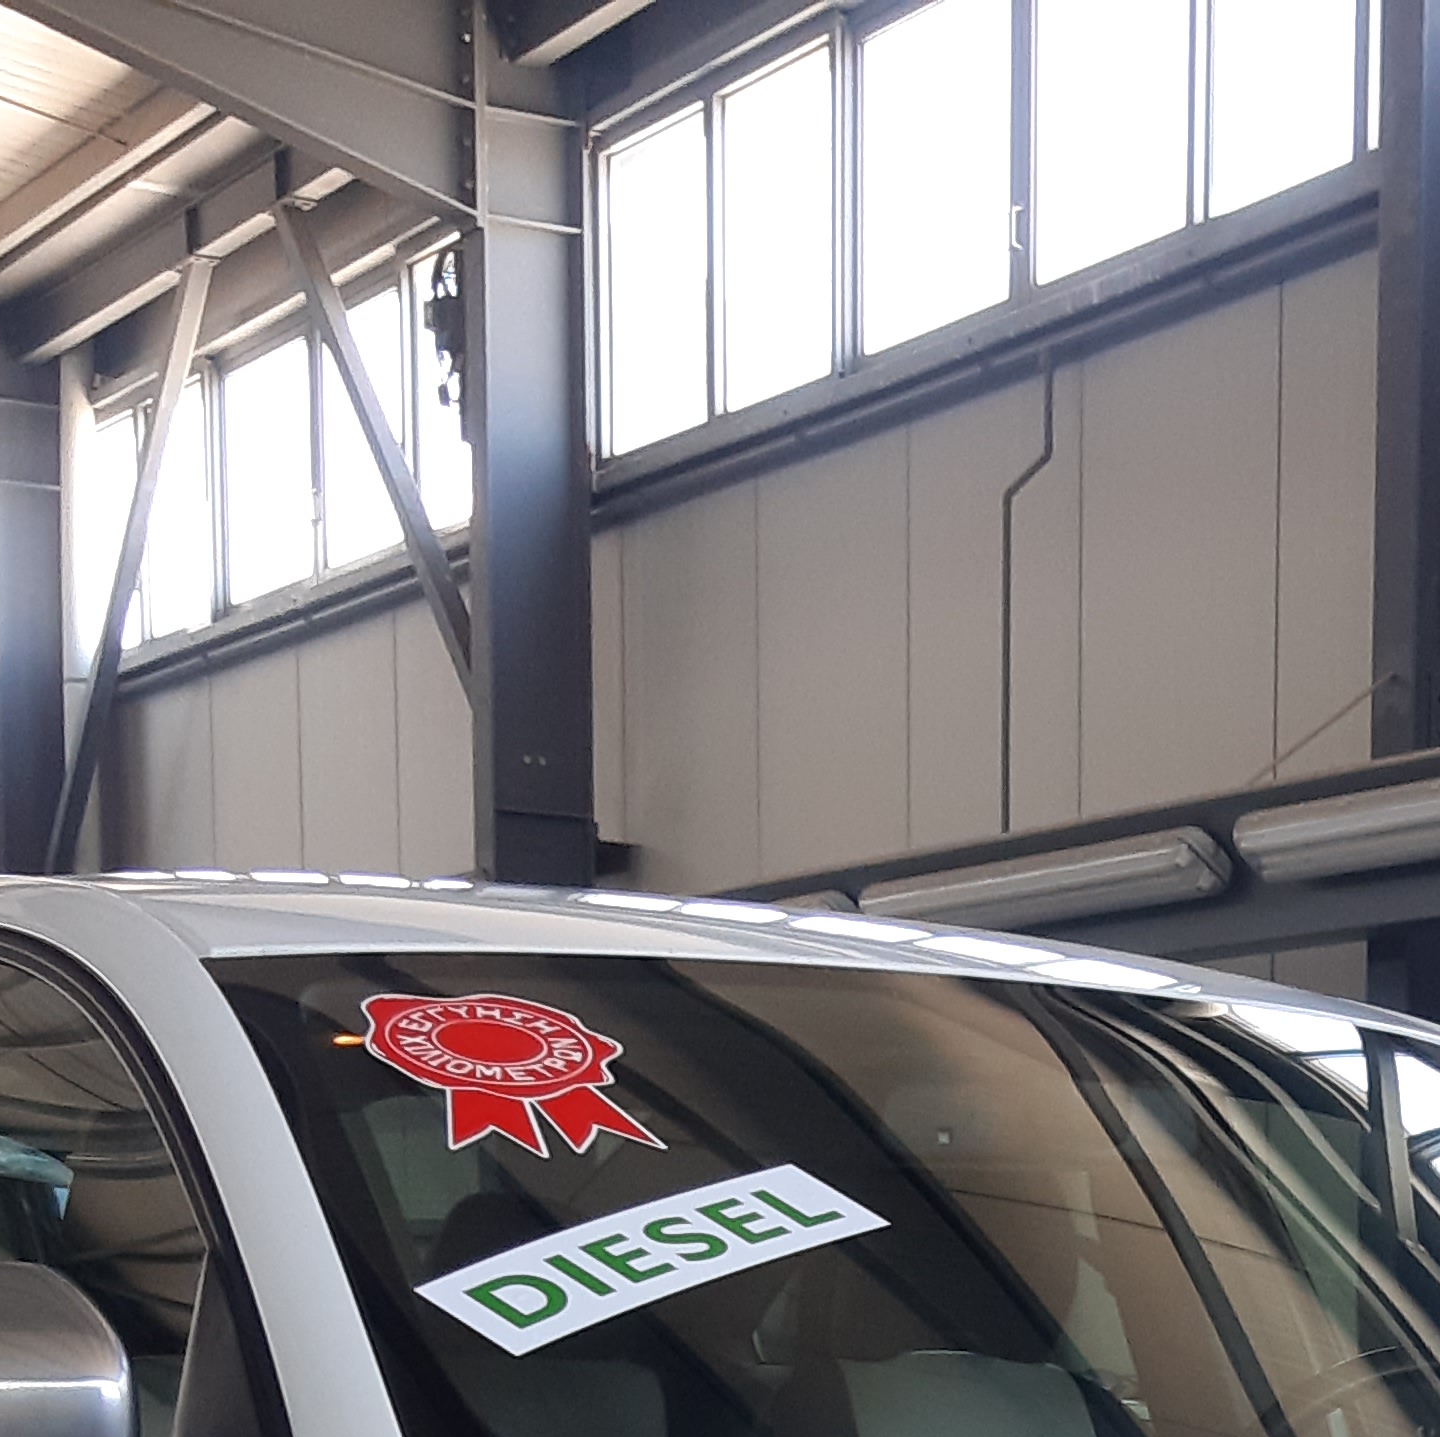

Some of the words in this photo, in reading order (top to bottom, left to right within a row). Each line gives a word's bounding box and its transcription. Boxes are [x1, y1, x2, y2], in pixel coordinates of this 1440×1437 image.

[397, 1003, 562, 1036] ΕΓΓΥΗΣΗ
[395, 1033, 584, 1082] ΧΙΛΙΟΜΕΤΡΩΝ
[461, 1188, 847, 1329] DIESEL
